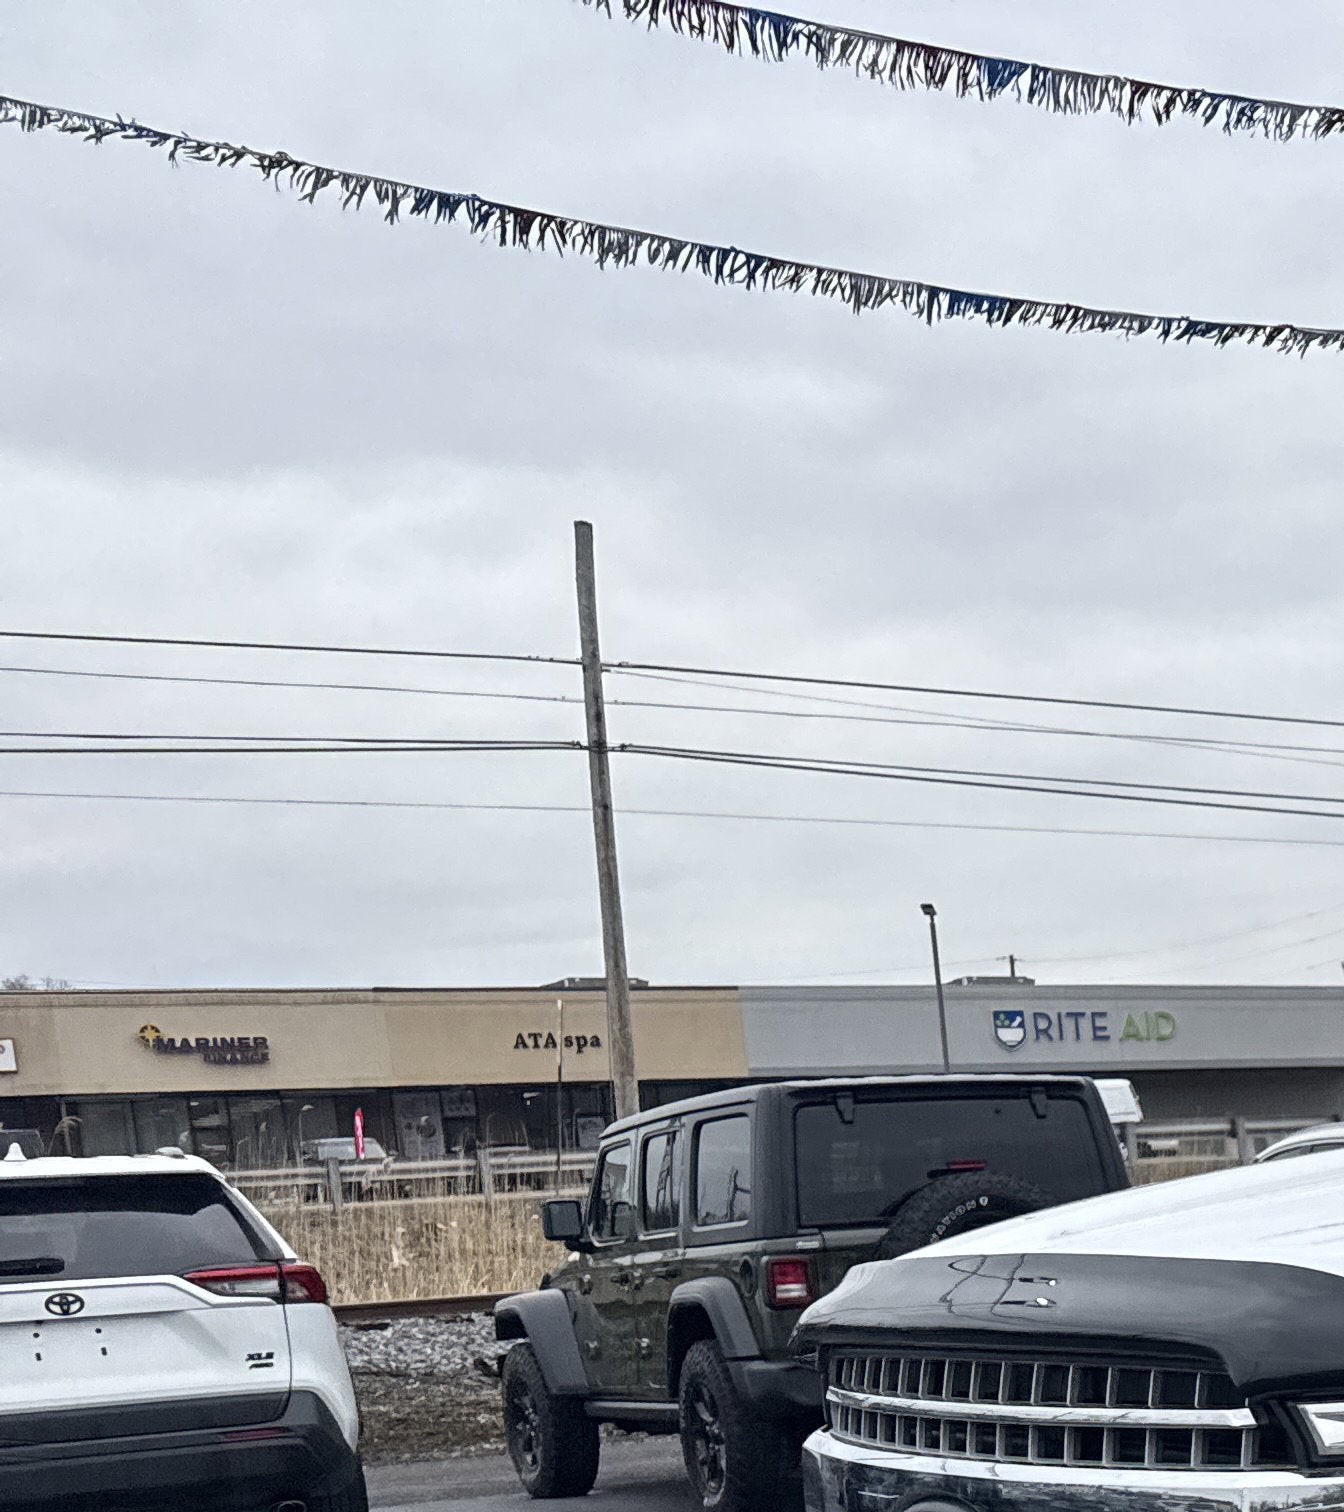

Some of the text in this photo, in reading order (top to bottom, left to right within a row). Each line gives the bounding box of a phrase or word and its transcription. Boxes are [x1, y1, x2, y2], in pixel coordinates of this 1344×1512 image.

[1033, 1010, 1177, 1042] RITE AID
[155, 1036, 269, 1051] MARINER
[514, 1032, 601, 1055] ATA spa
